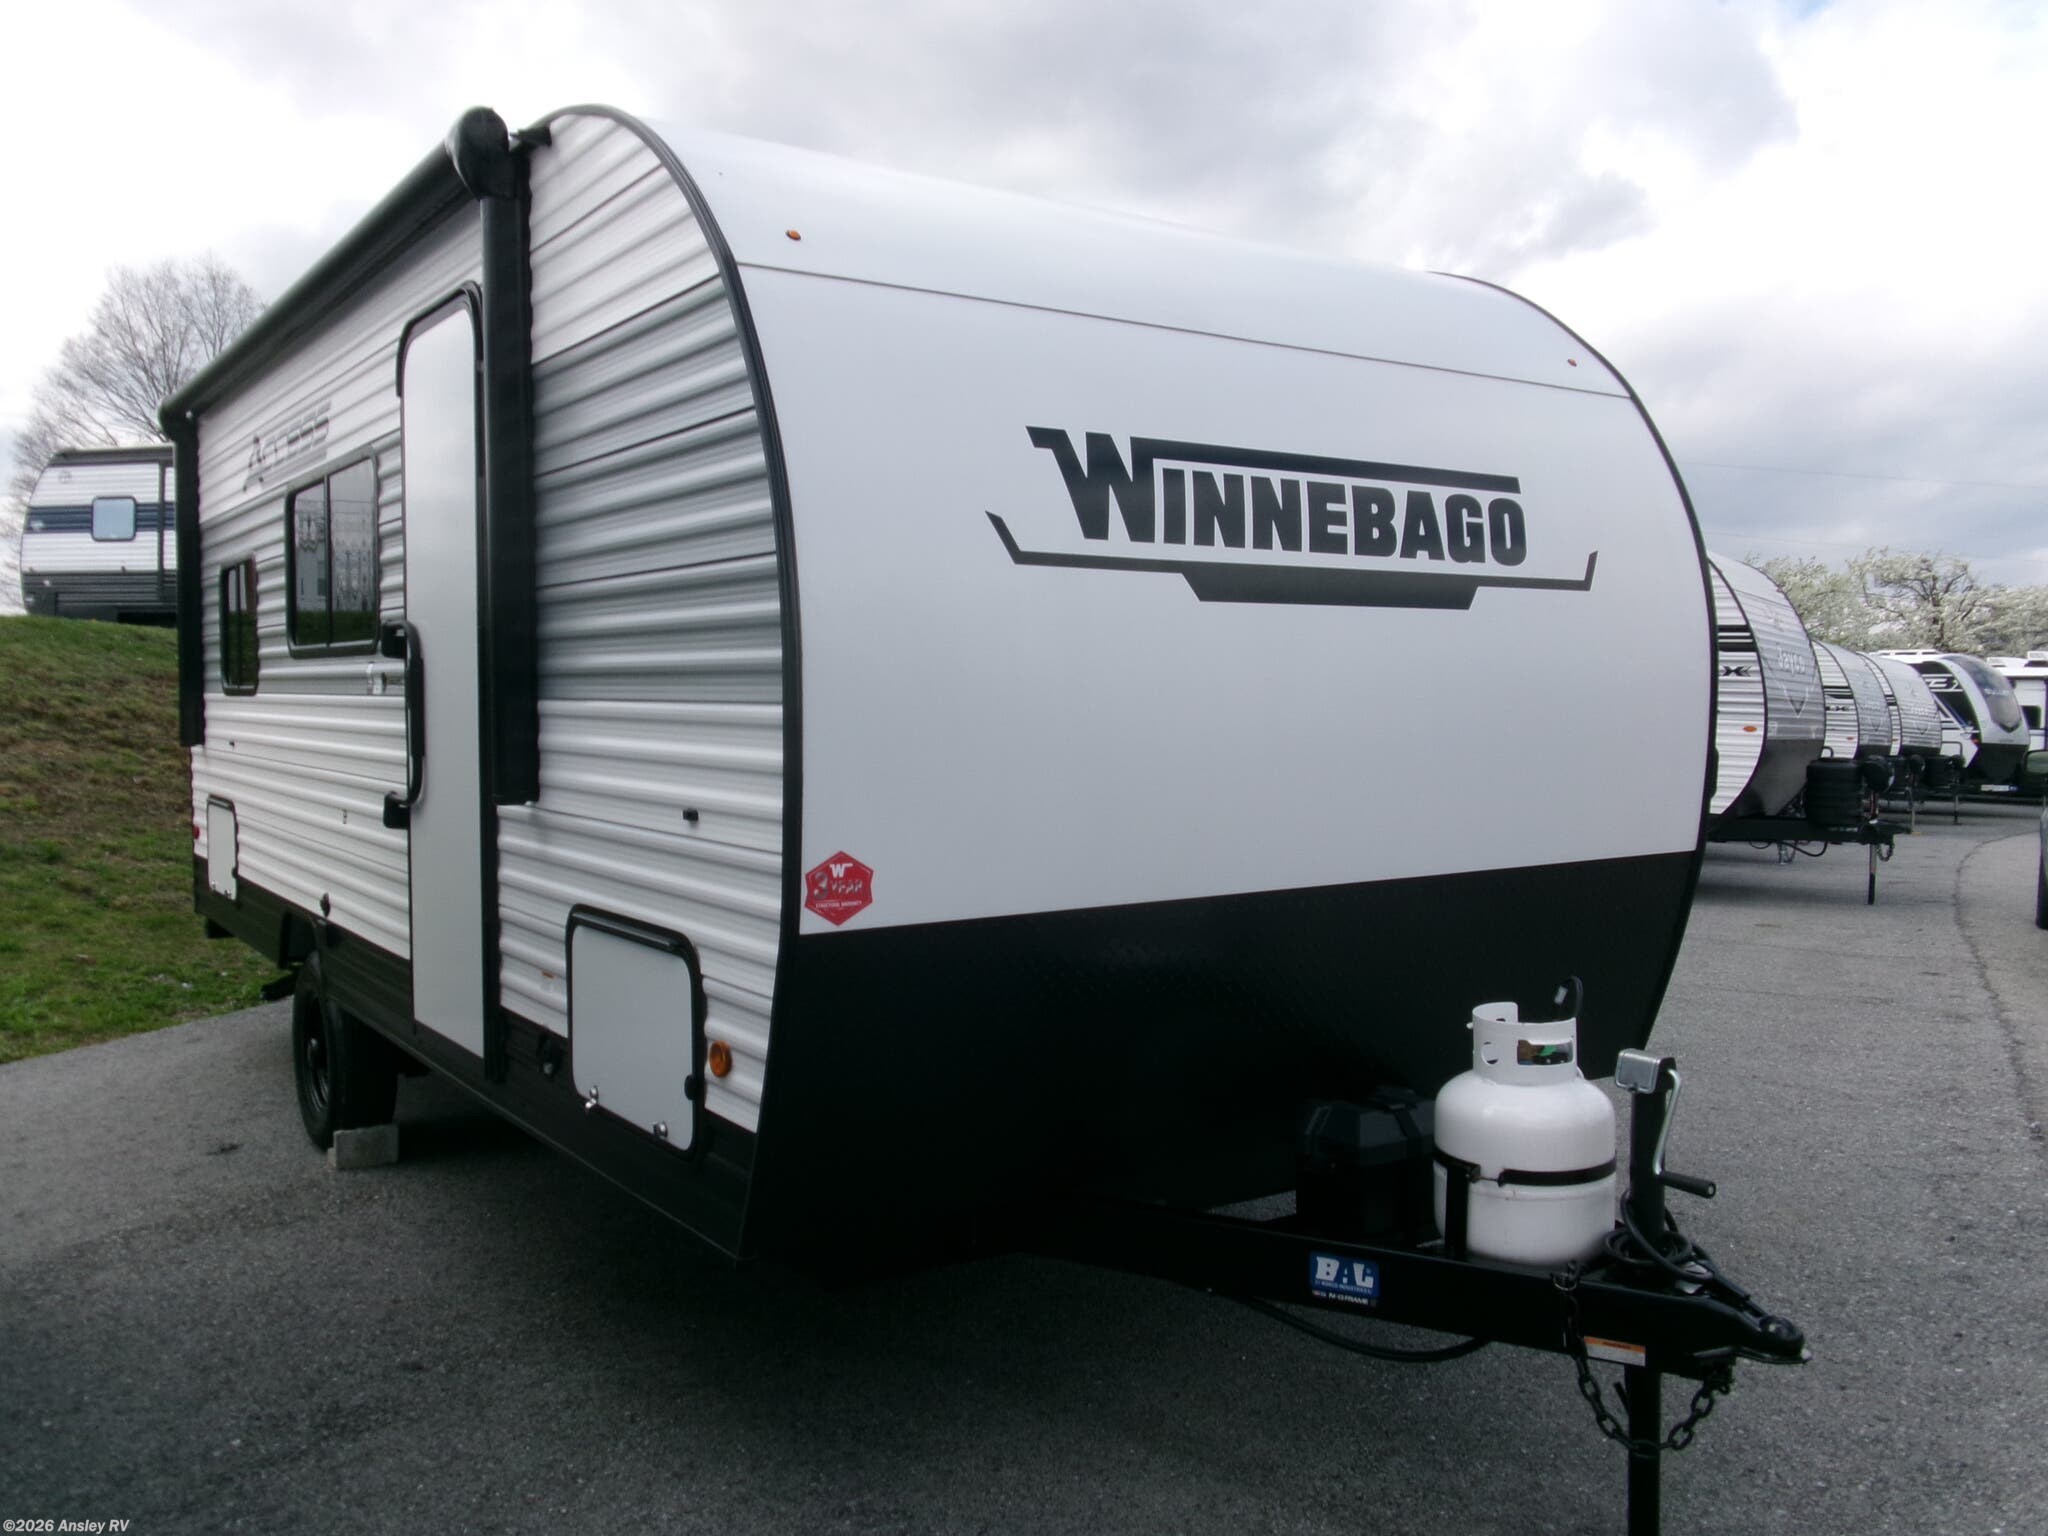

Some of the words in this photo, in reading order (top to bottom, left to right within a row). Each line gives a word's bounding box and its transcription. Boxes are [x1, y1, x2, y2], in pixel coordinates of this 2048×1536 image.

[1025, 425, 1527, 566] WINNEBAGO
[813, 871, 829, 898] 3
[831, 879, 863, 894] YEAR
[1315, 1256, 1374, 1288] BAL
